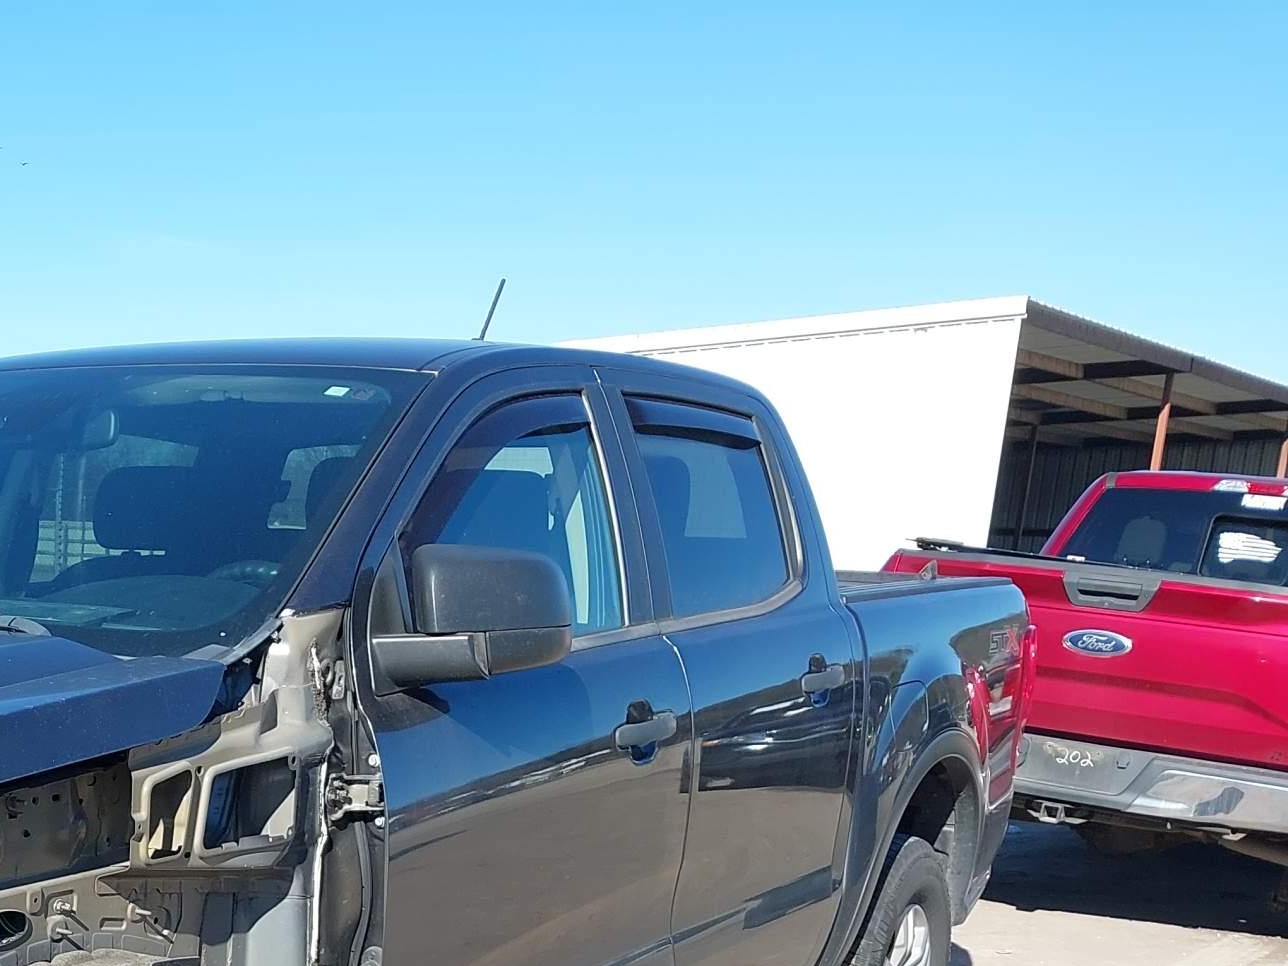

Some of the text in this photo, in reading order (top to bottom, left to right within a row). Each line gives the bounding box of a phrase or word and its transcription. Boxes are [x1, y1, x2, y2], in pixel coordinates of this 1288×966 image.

[988, 624, 1019, 655] STX
[1078, 634, 1115, 653] Ford
[1055, 748, 1094, 767] 202
